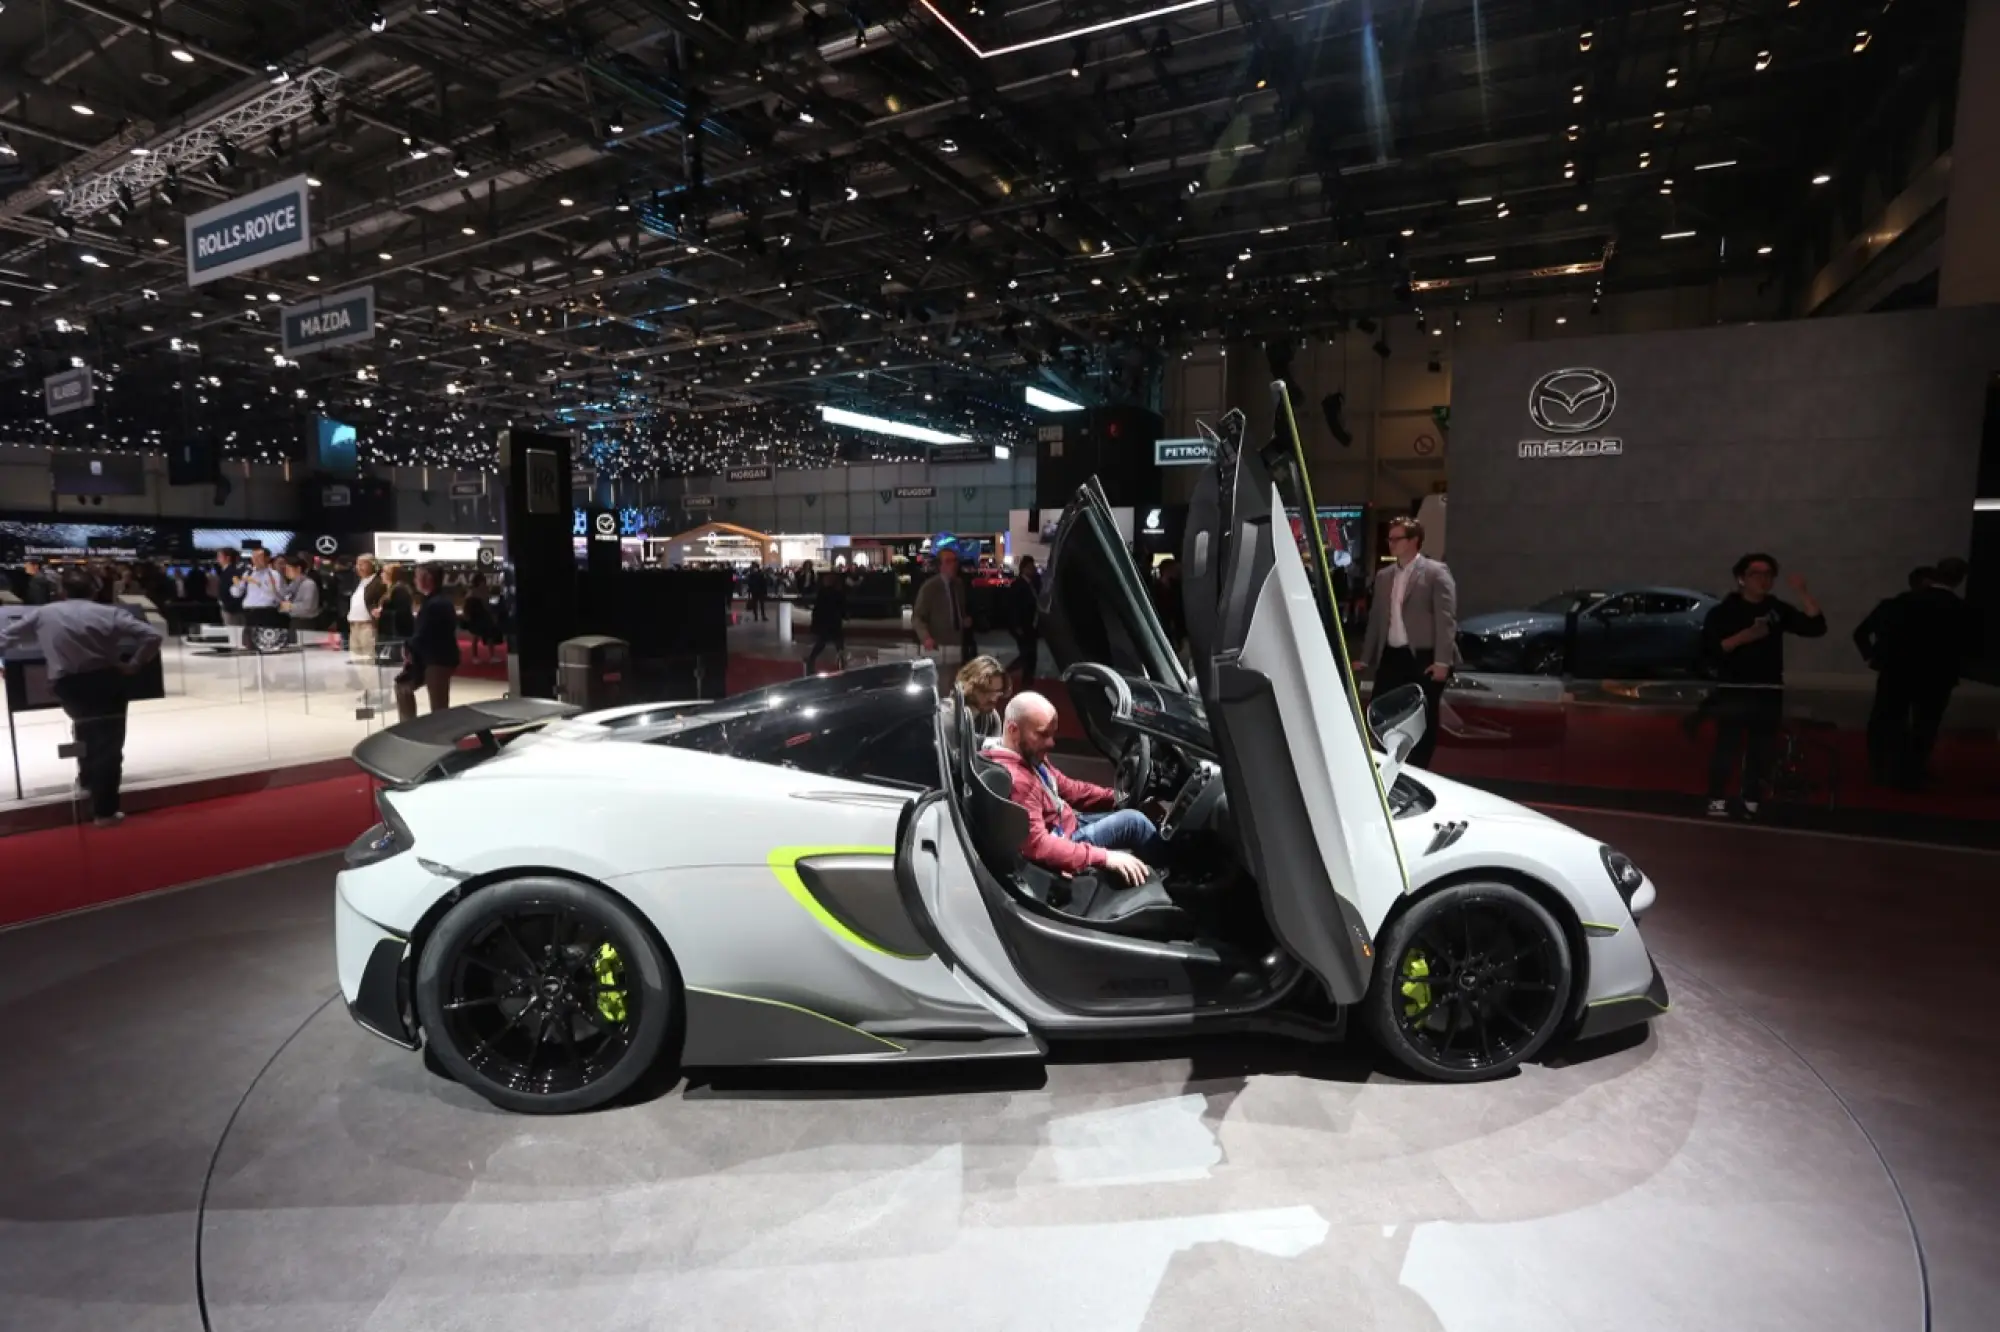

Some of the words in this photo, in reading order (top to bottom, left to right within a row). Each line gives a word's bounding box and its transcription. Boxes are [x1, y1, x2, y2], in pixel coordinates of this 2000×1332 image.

[197, 206, 296, 257] ROLLS-ROYCE
[300, 308, 351, 338] MAZDA
[730, 468, 767, 480] MORGAN
[897, 487, 932, 497] PEUGEOT
